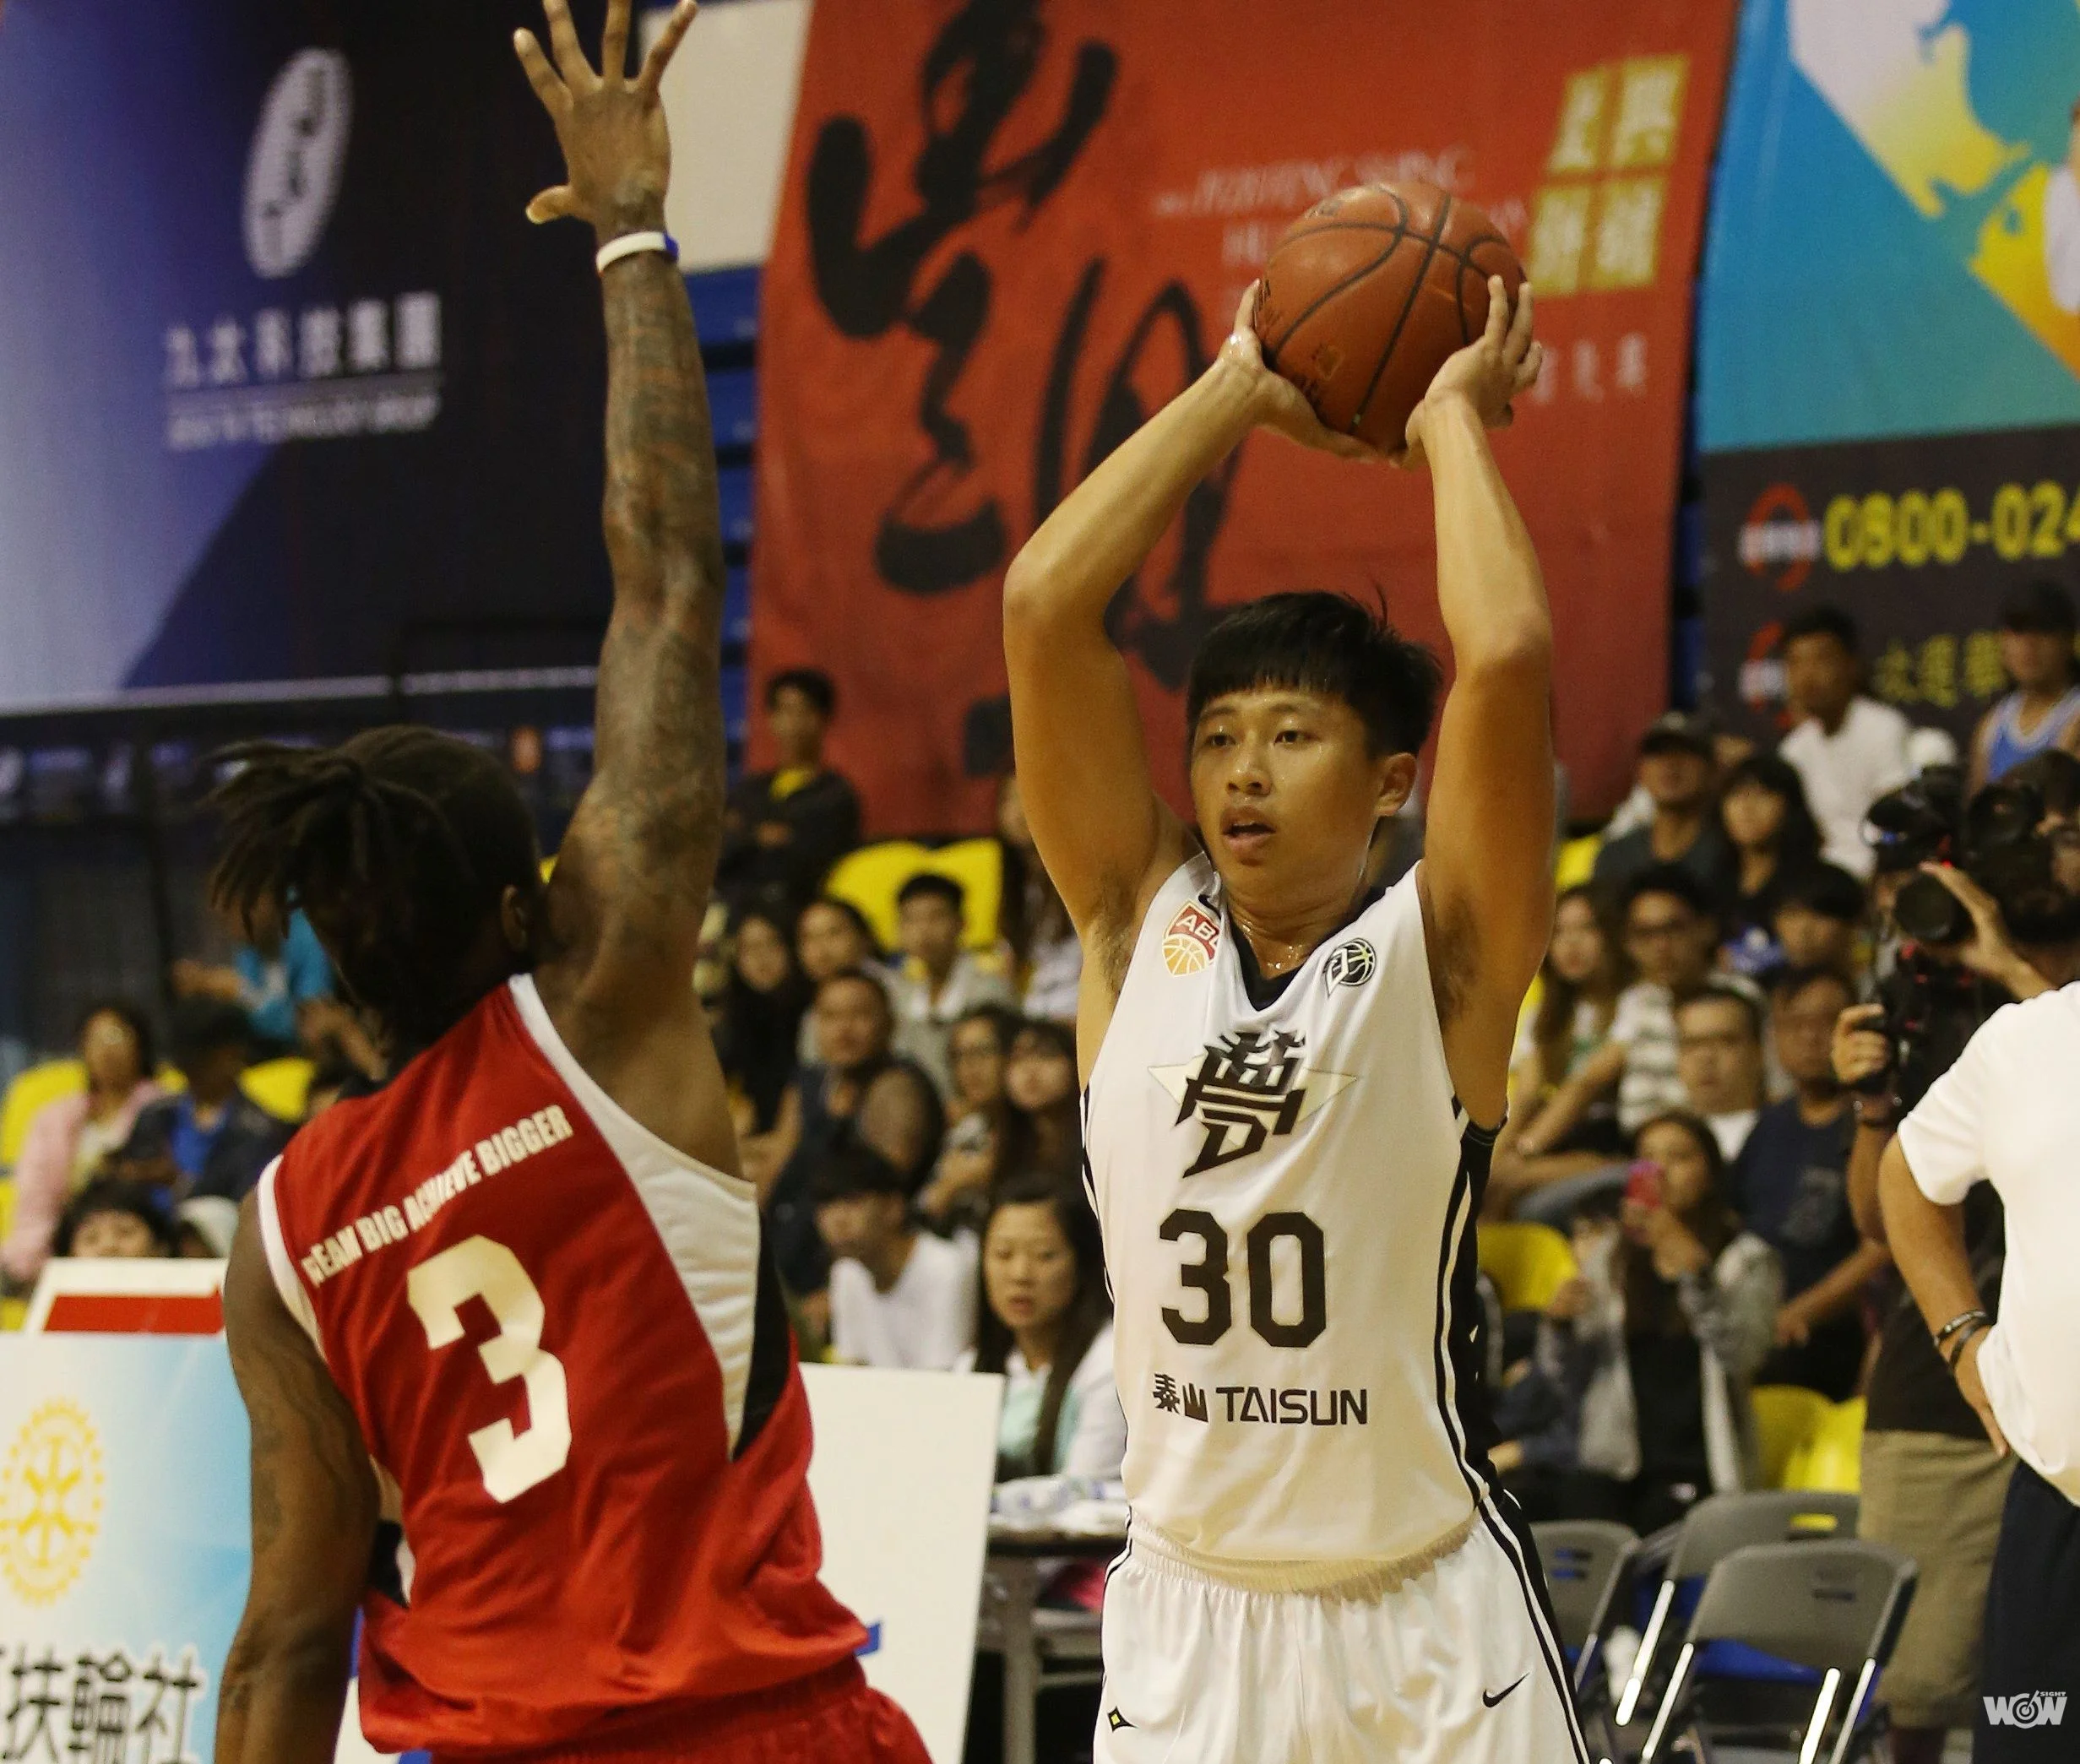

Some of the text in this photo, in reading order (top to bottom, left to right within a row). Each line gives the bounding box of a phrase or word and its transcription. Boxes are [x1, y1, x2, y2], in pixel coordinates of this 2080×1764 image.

[355, 1205, 410, 1253] BIG
[475, 1105, 574, 1177] BIGGER
[1159, 1208, 1327, 1348] 30
[407, 1234, 573, 1504] 3
[1153, 1373, 1367, 1425] 泰山 TAISUN
